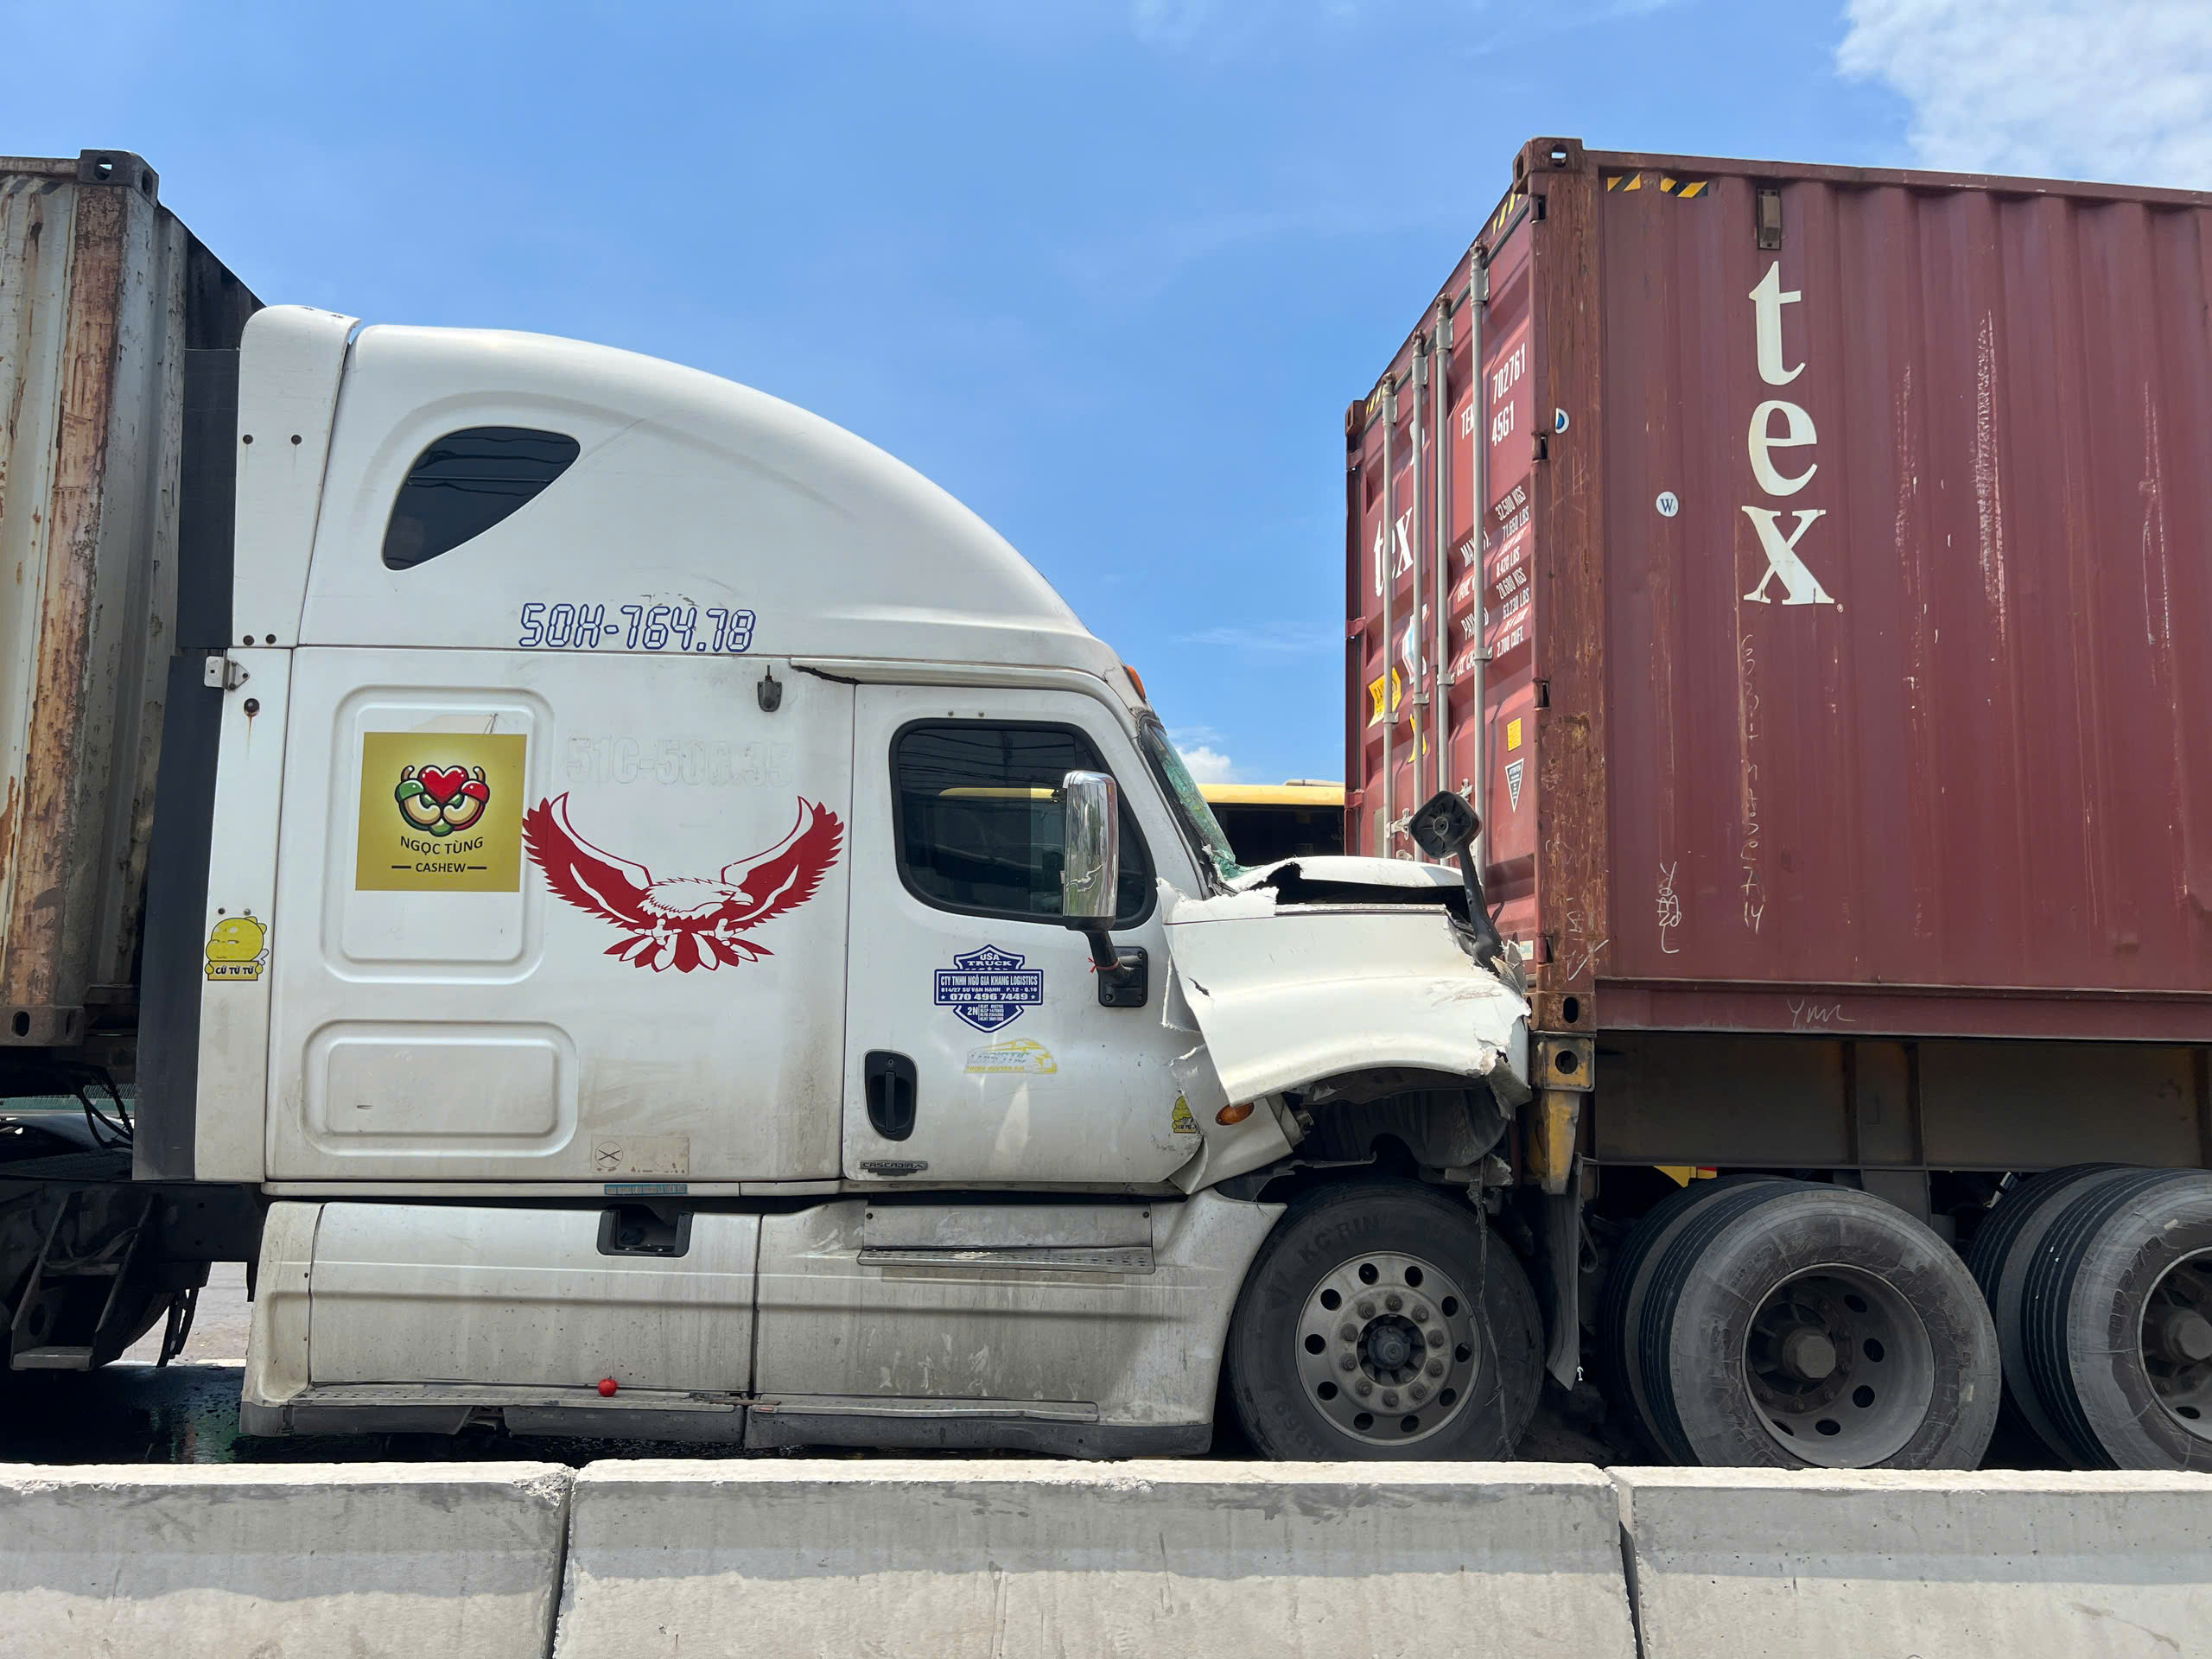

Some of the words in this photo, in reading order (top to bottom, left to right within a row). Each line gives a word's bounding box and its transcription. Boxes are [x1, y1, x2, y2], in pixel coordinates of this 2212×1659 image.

[1493, 342, 1526, 405] 702761
[1492, 400, 1514, 447] 45G1
[1741, 260, 1834, 605] tex
[519, 602, 757, 653] 50H-764.78
[400, 836, 441, 855] NGỌC
[444, 836, 484, 855] TÙNG
[416, 862, 467, 873] CASHEW
[979, 952, 1000, 961] USA
[941, 976, 950, 986] CTY
[952, 976, 967, 986] TNHH
[980, 976, 990, 986] GIA
[990, 976, 1009, 986] KHANG
[1010, 976, 1038, 986] LOGISTICS
[967, 1006, 978, 1016] 2N
